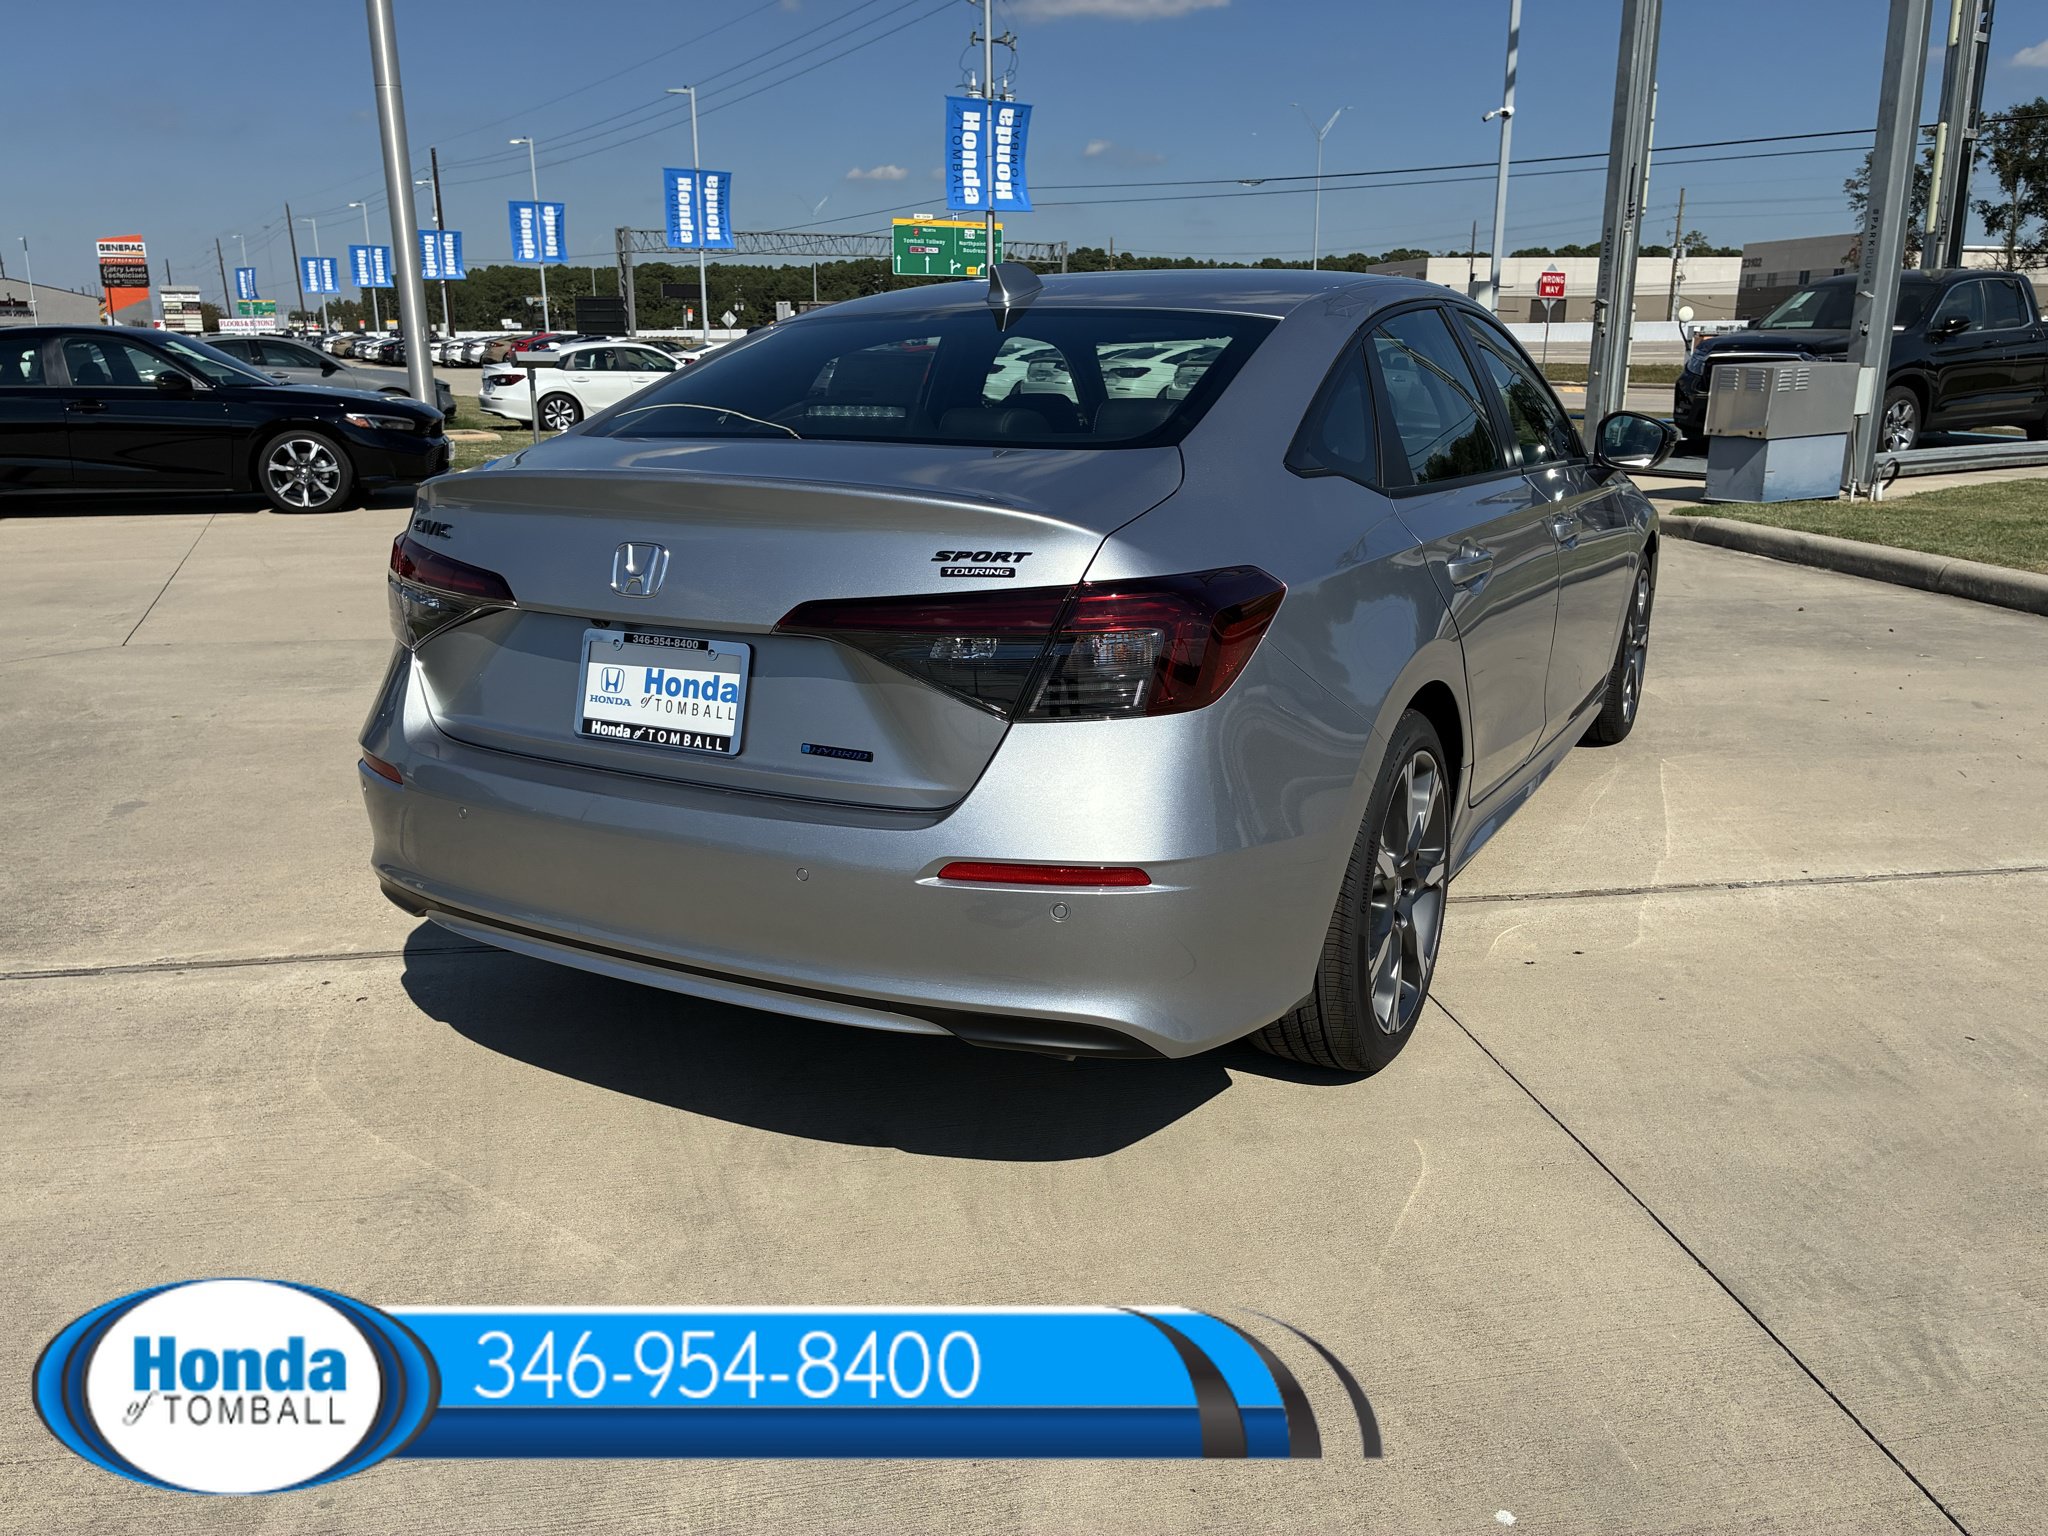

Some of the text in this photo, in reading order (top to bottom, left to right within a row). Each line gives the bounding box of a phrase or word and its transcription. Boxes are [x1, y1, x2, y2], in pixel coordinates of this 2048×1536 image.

[952, 124, 964, 204] TOMBALL
[962, 111, 981, 205] Honda
[995, 108, 1015, 200] Honda
[1011, 111, 1024, 188] TOMBALL
[677, 177, 694, 244] Honda
[704, 175, 721, 240] Honda
[98, 243, 143, 251] GENERAC
[520, 207, 535, 259] Honda
[543, 206, 558, 257] Honda
[1864, 216, 1879, 277] PARKPLUS
[356, 249, 369, 285] Honda
[373, 248, 385, 284] Honda
[424, 235, 437, 278] Honda
[443, 233, 457, 276] Honda
[1542, 275, 1565, 284] WRONG
[1545, 285, 1561, 294] WAY
[413, 518, 454, 539] CIVIC
[930, 550, 1033, 564] SPORT
[944, 567, 1011, 576] TOURING
[589, 694, 632, 707] HONDA
[643, 667, 739, 704] Honda
[640, 694, 735, 721] of TOMBALL
[591, 720, 724, 751] Honda of TOMBALL
